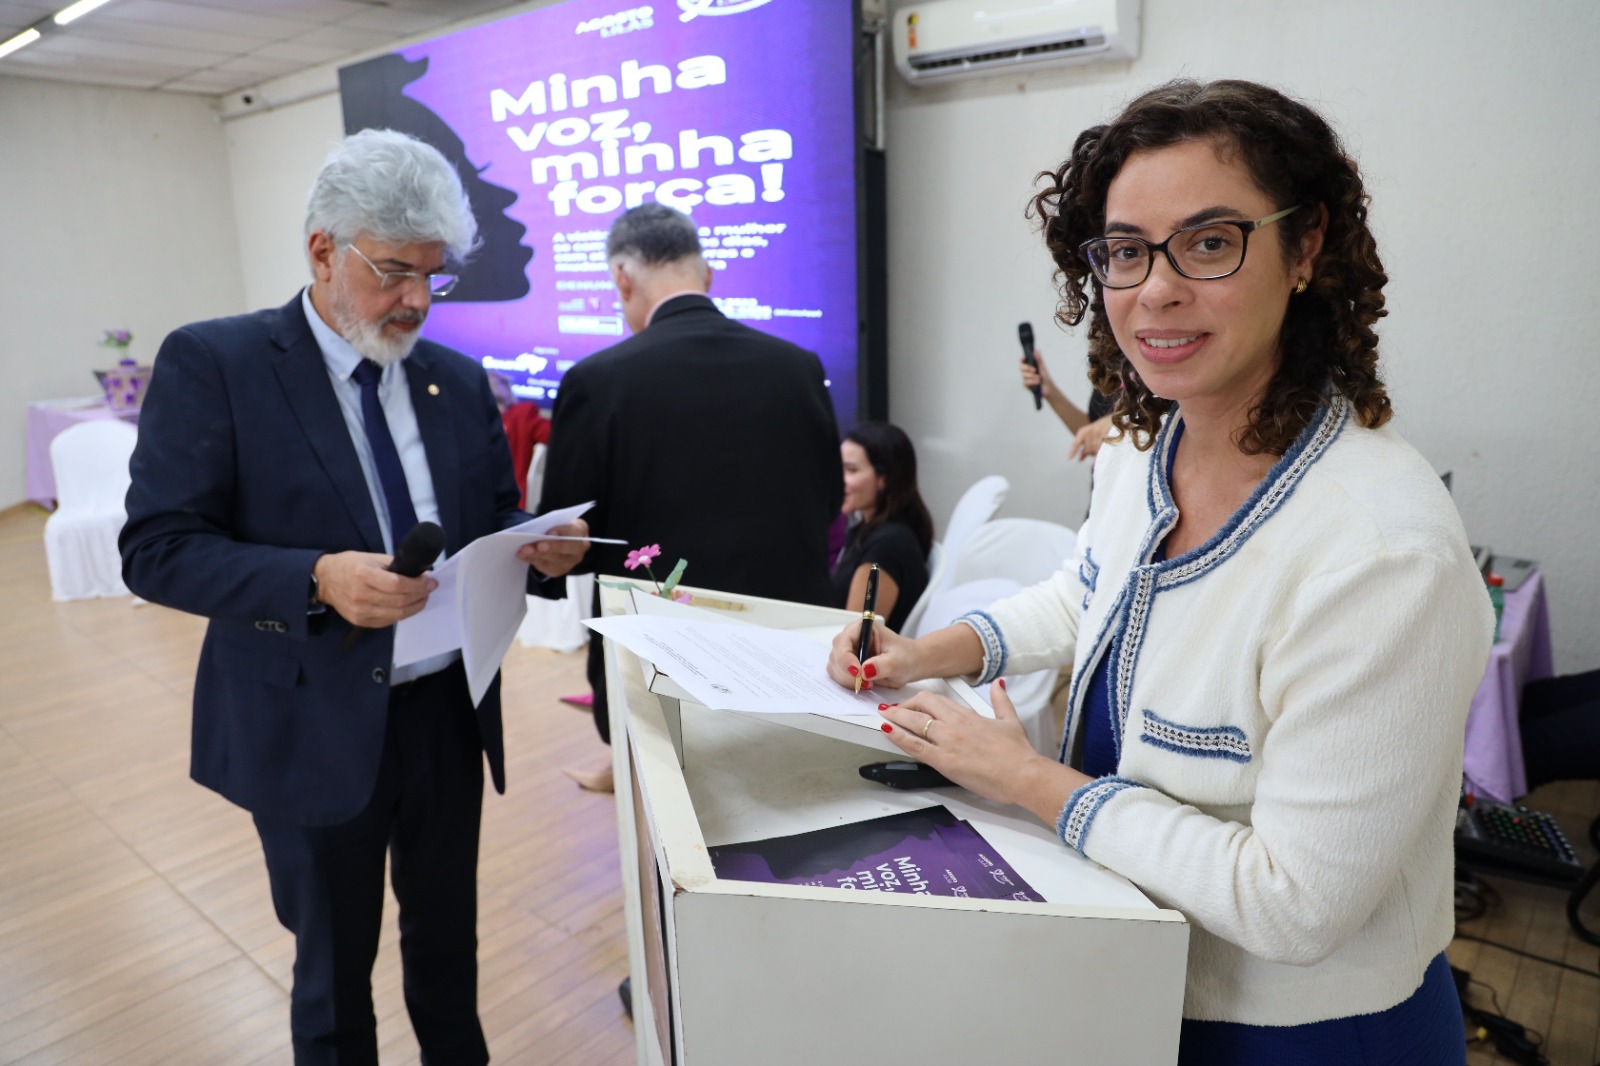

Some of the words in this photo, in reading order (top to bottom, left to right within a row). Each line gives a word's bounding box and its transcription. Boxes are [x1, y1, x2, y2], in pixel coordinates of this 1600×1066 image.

[490, 55, 727, 122] Minha
[506, 108, 652, 152] voz,
[531, 128, 793, 184] minha
[548, 162, 785, 216] força!
